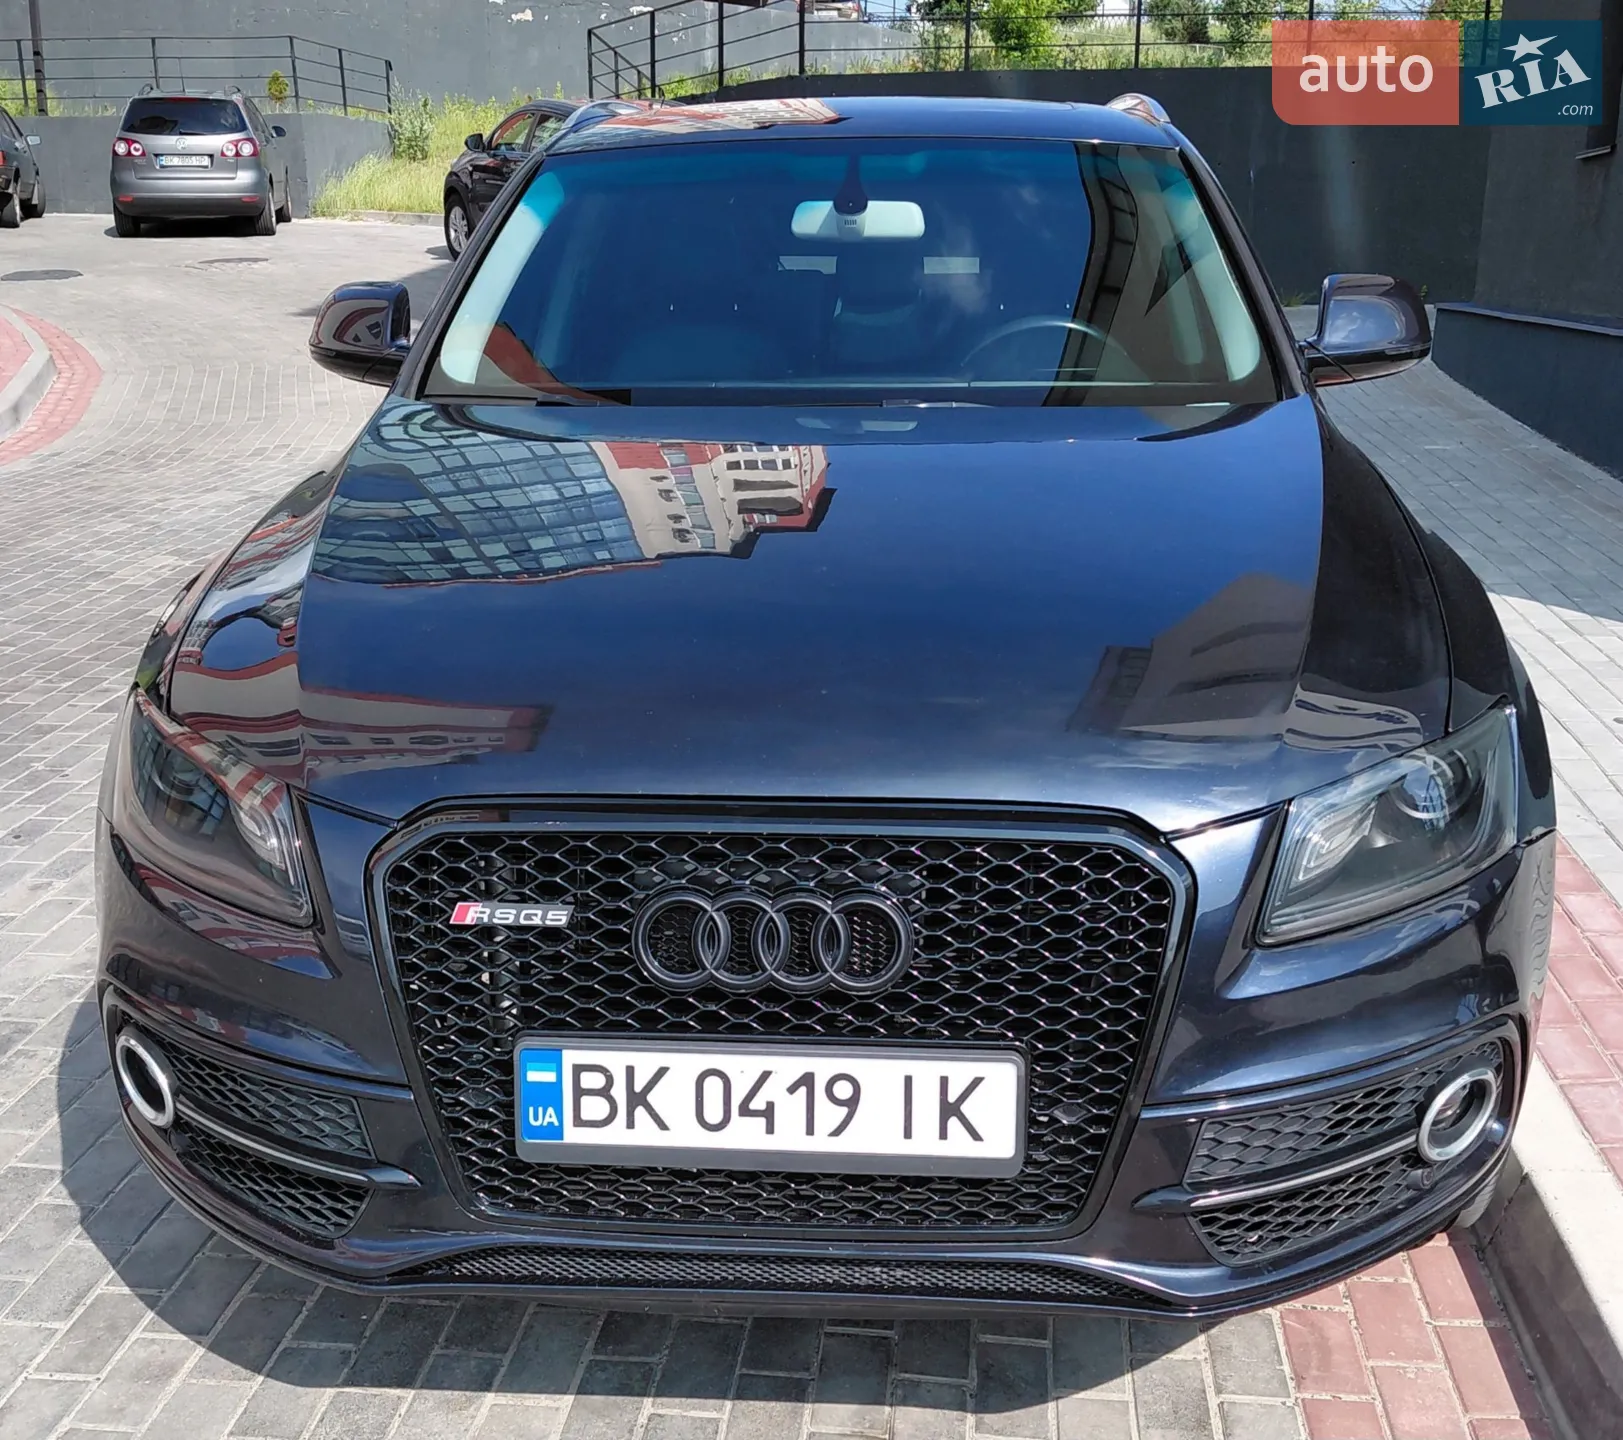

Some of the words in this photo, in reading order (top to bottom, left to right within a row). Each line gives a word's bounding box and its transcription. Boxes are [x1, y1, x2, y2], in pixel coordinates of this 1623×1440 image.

[463, 906, 569, 926] RSQ5
[572, 1063, 670, 1131] BK
[695, 1068, 861, 1137] 0419
[903, 1075, 985, 1142] IK
[529, 1106, 559, 1126] UA
